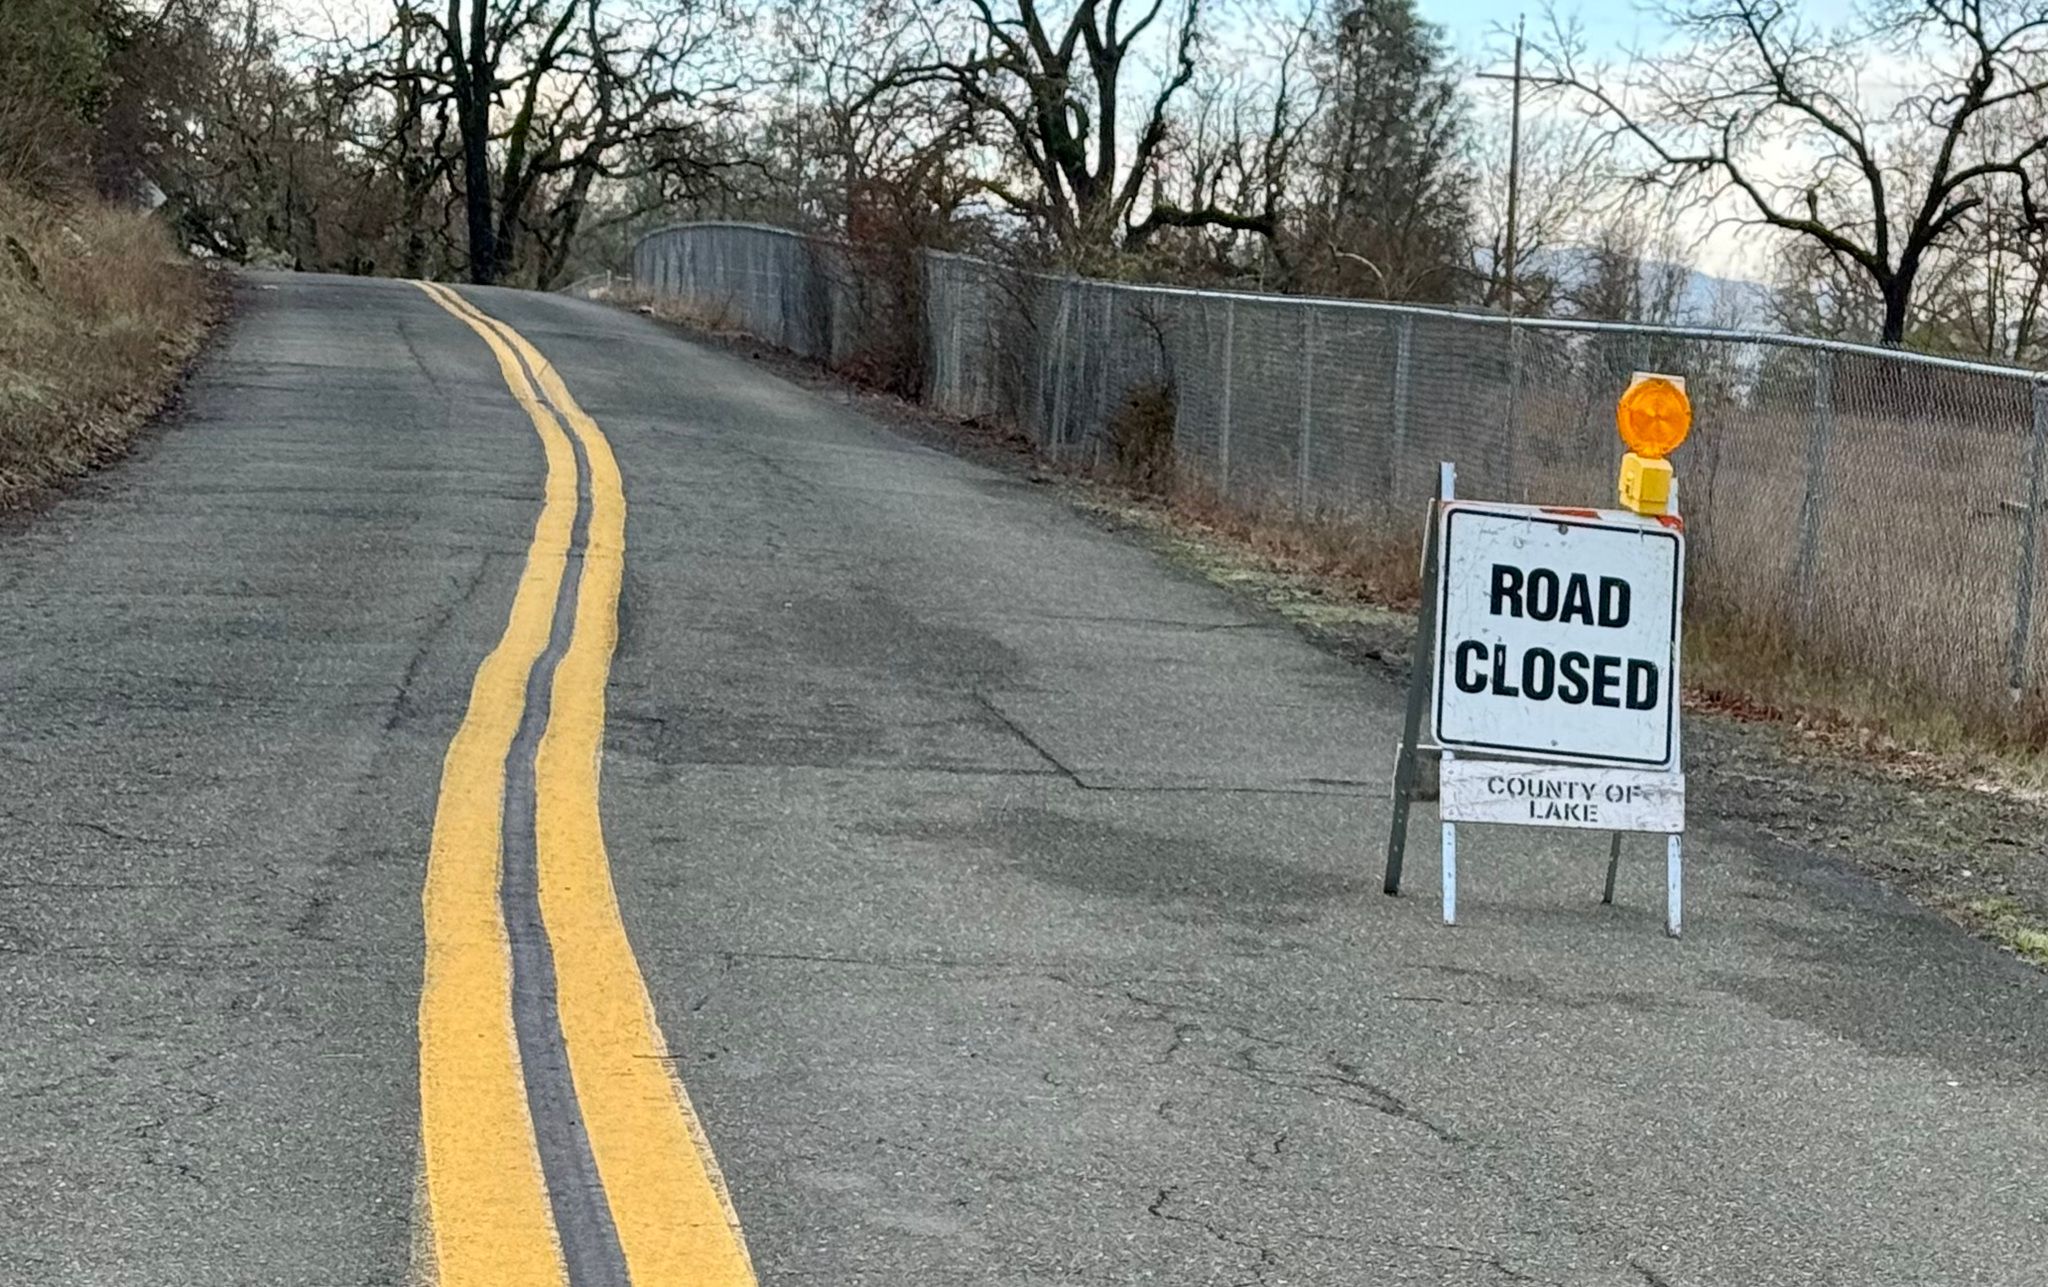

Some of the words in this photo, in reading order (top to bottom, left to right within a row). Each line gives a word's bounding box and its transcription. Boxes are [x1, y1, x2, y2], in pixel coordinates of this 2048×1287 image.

[1490, 563, 1631, 628] ROAD
[1455, 640, 1659, 710] CLOSED
[1487, 777, 1596, 801] COUNTY
[1605, 784, 1642, 804] OF
[1529, 801, 1599, 823] LAKE
